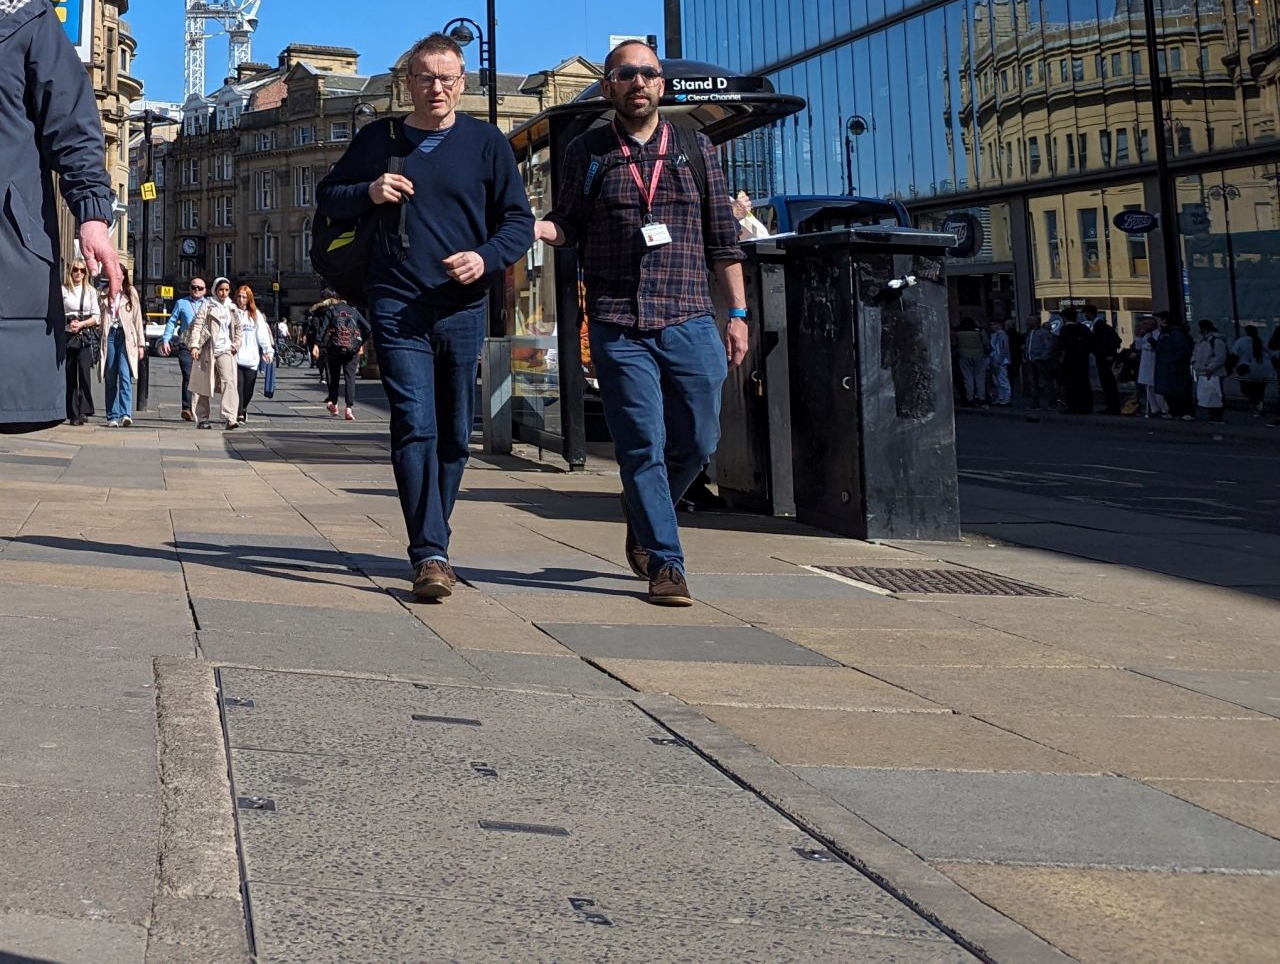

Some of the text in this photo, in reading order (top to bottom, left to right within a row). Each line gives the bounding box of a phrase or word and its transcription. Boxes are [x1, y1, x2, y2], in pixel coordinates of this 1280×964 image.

[672, 77, 728, 91] Stand D
[687, 93, 742, 102] Clear Channel
